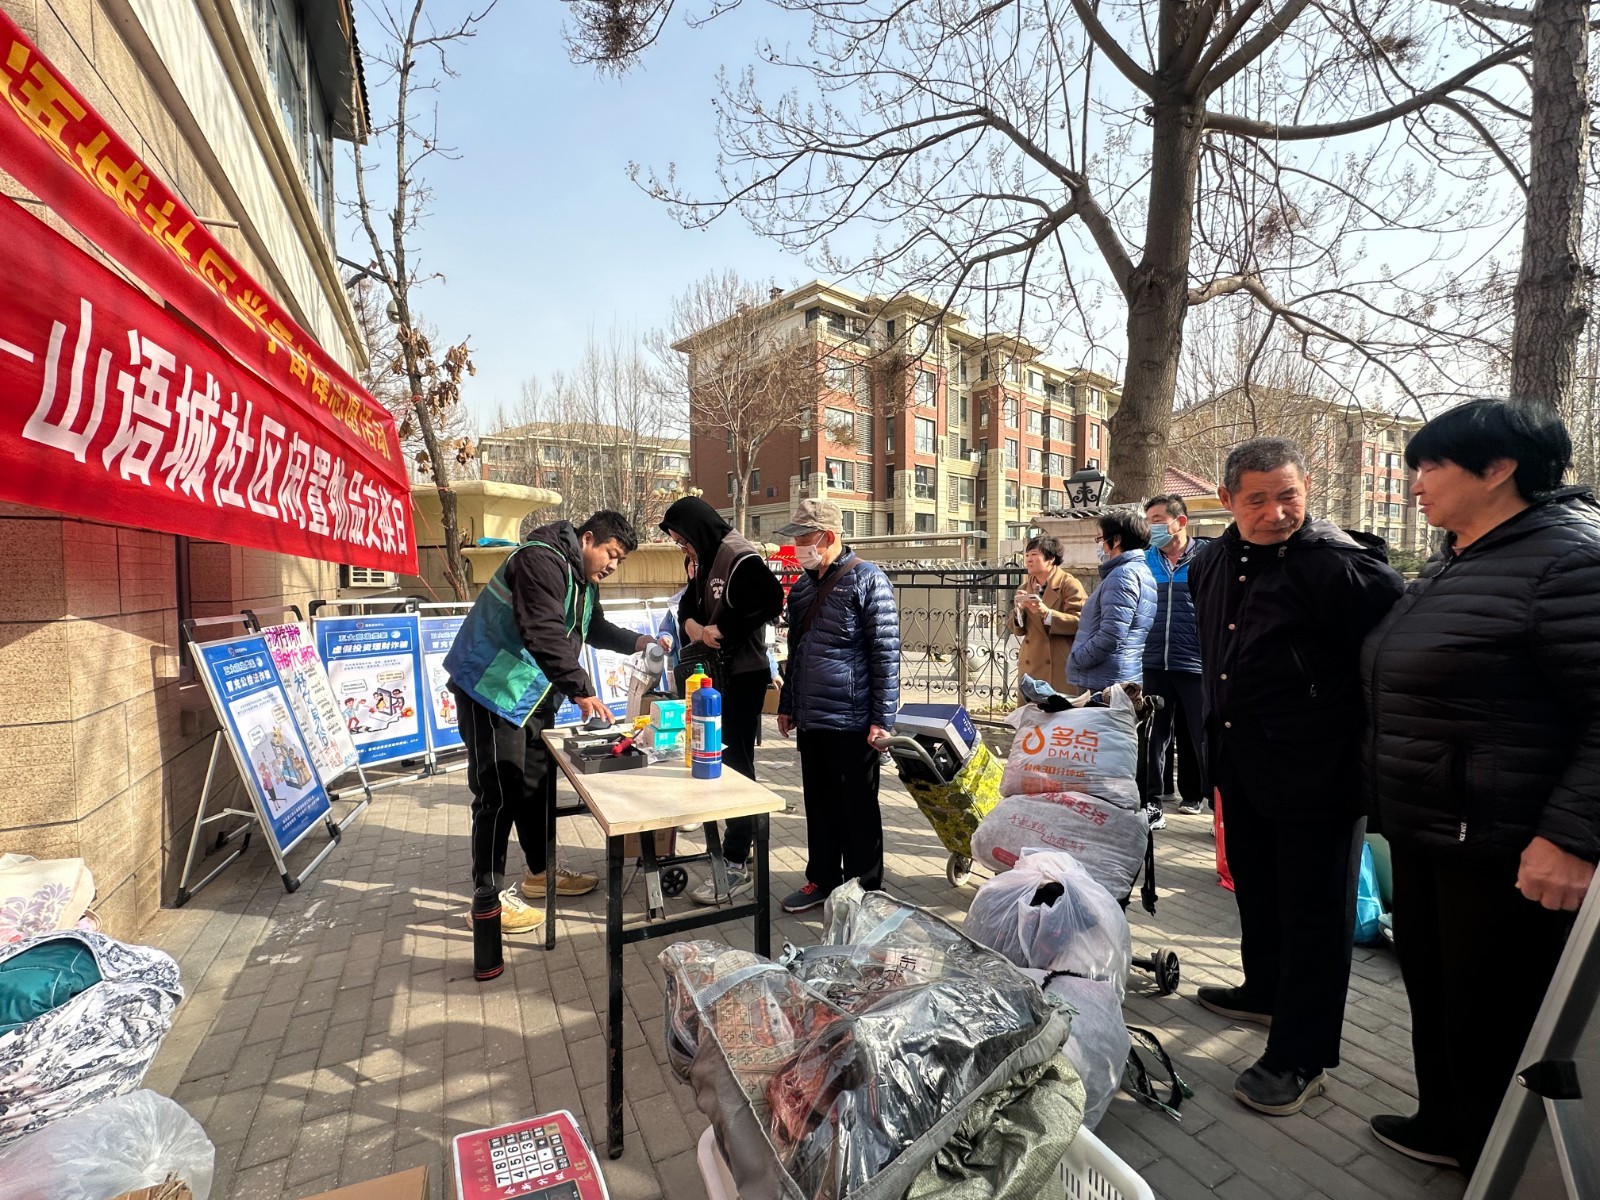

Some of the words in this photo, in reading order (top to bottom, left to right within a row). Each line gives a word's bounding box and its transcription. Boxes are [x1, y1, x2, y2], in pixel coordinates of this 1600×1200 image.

[331, 640, 409, 655] 虚假投资理财诈骗
[225, 669, 272, 693] 冒充公检法诈骗
[1049, 726, 1099, 752] 多点
[1048, 748, 1097, 764] DMALL
[1043, 792, 1110, 826] 永辉生活
[522, 1142, 533, 1150] 3
[493, 1151, 504, 1159] 9
[508, 1147, 519, 1155] 6
[510, 1158, 522, 1167] 5
[525, 1154, 537, 1162] 2
[495, 1161, 507, 1171] 8
[543, 1163, 554, 1171] 0
[497, 1176, 510, 1184] 7
